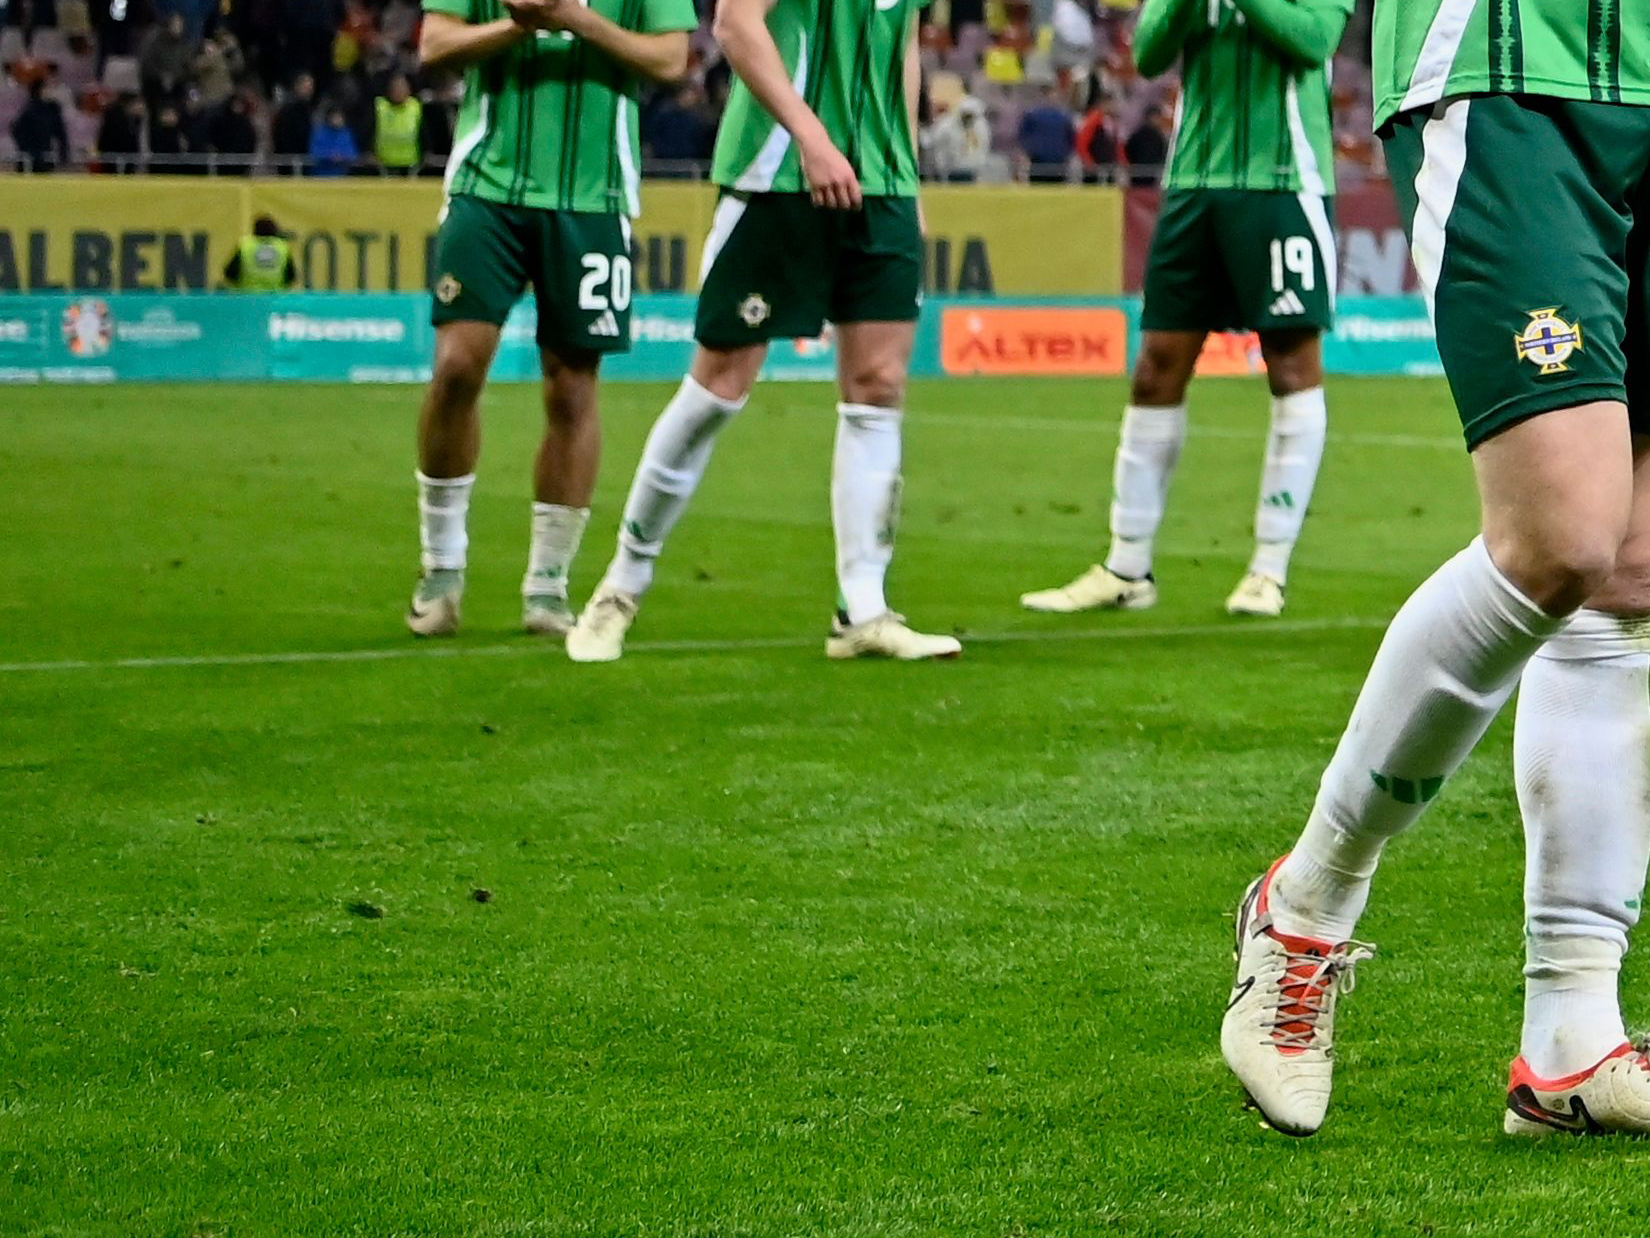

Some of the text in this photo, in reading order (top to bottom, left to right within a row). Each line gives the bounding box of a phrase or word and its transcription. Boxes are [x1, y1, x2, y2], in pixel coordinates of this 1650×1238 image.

[578, 252, 631, 312] 20
[1270, 235, 1314, 292] 19
[268, 312, 404, 341] Hisense
